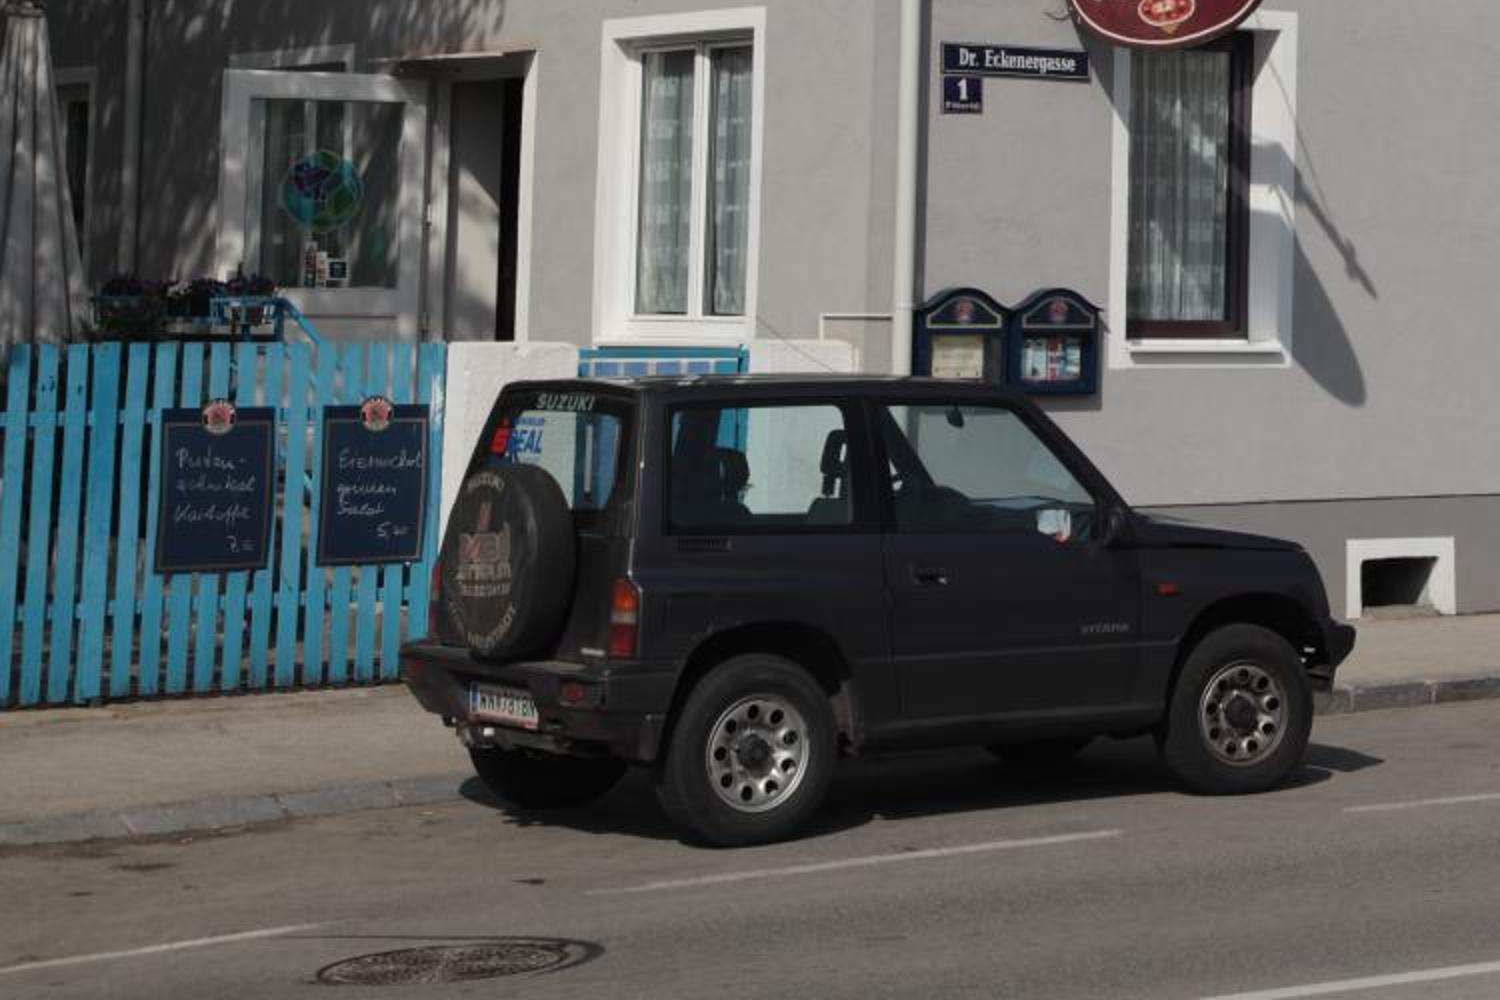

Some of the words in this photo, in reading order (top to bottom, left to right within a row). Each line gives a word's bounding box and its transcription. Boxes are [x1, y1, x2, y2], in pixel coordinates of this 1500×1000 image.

[959, 48, 979, 67] Dr.
[984, 50, 1076, 73] Eckenergasse
[957, 78, 968, 101] 1
[536, 393, 596, 411] SUZUKI
